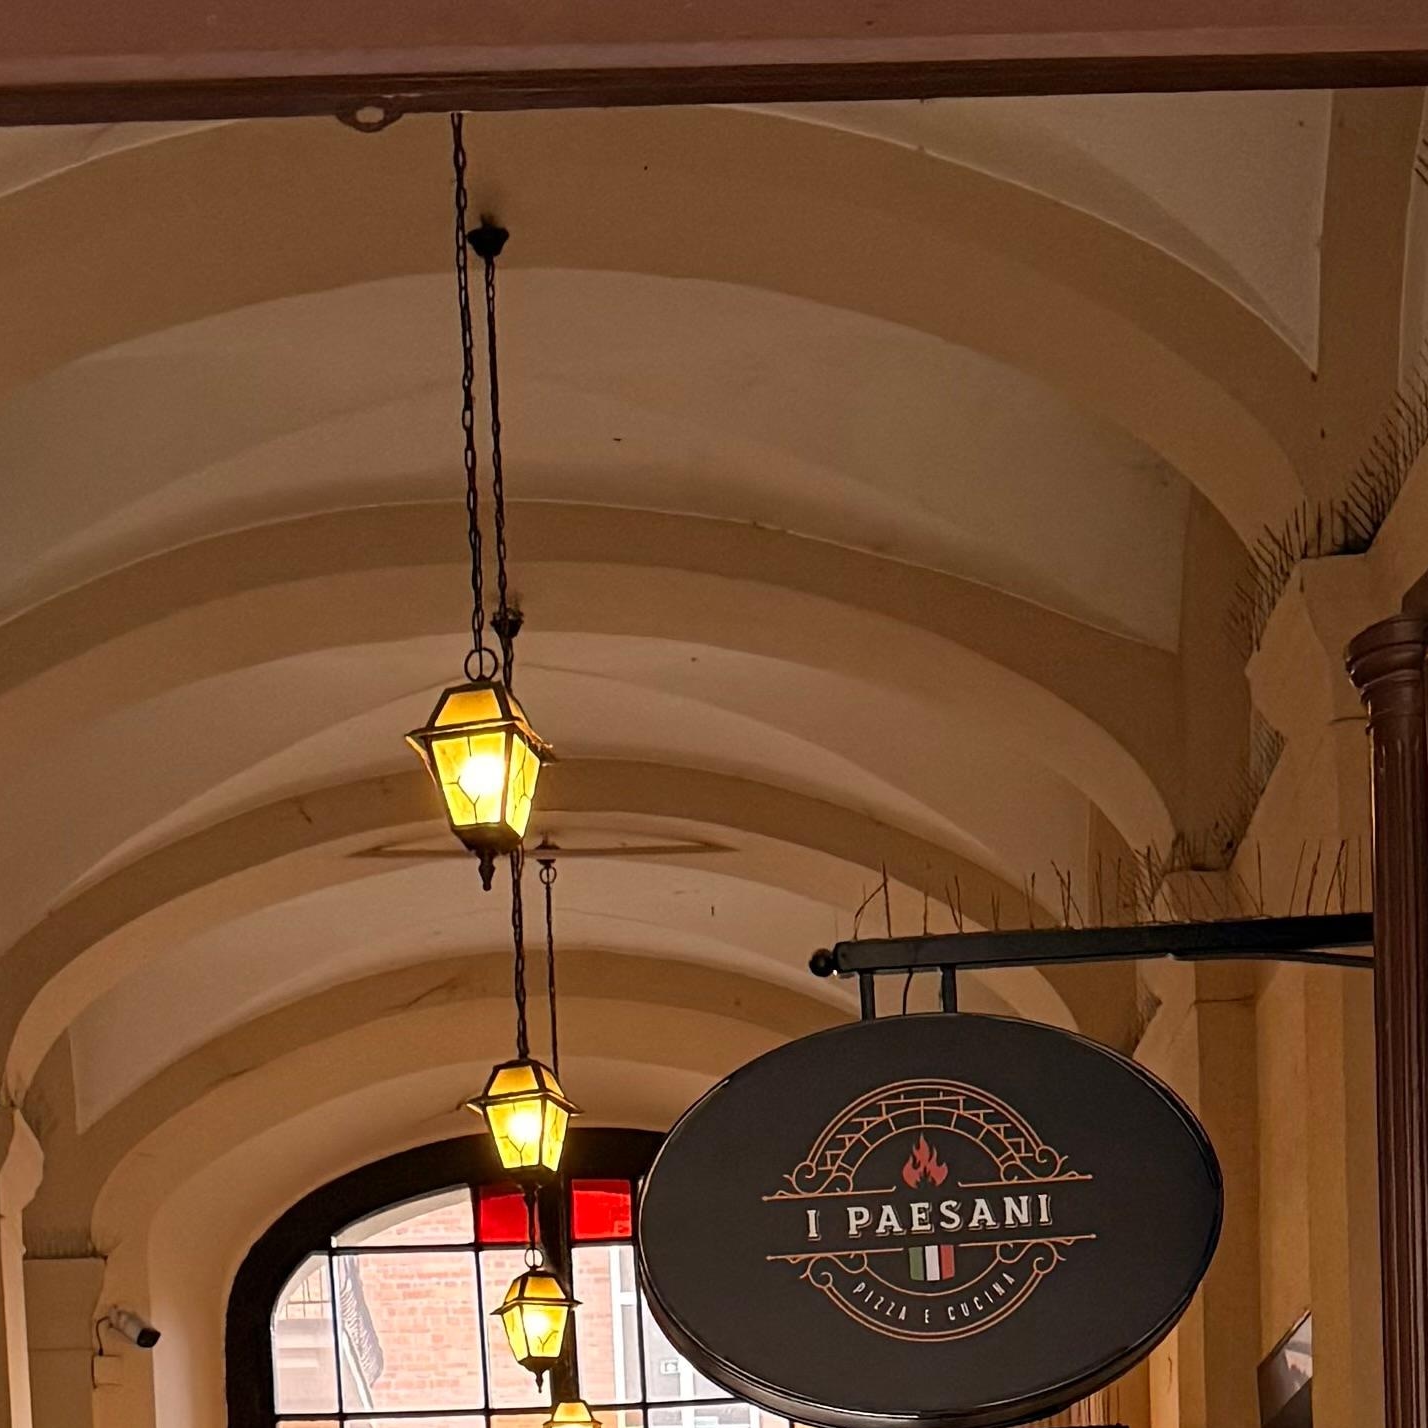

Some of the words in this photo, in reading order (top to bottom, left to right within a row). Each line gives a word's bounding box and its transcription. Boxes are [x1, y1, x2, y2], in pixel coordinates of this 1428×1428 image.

[806, 1209, 821, 1240] I
[846, 1193, 1053, 1238] PAESANI
[852, 1281, 908, 1322] PIZZA
[924, 1308, 931, 1324] E
[947, 1271, 1016, 1322] CUCINA
